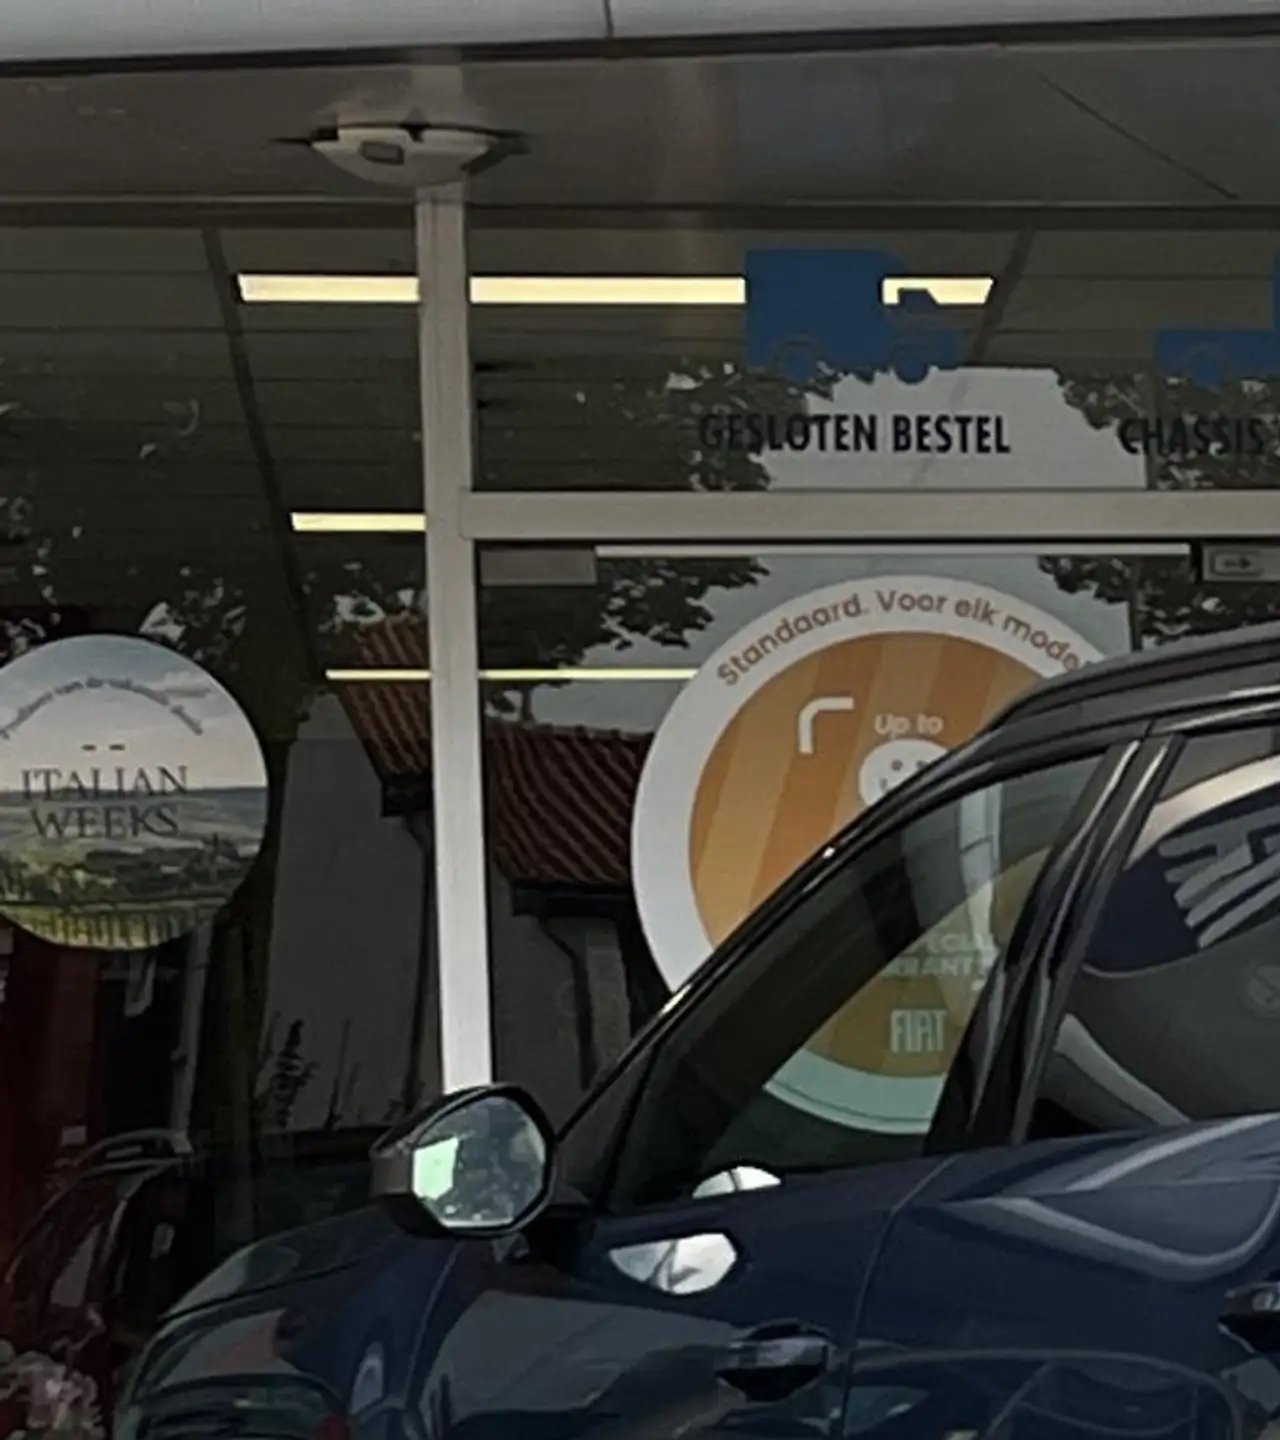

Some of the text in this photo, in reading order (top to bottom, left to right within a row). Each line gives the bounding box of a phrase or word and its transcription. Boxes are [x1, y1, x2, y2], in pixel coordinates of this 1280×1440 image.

[702, 413, 1012, 454] GESLOTEN BESTEL
[1116, 417, 1266, 455] CHASSIS
[875, 588, 947, 614] Voor
[953, 596, 999, 627] elk
[1002, 613, 1092, 674] mode
[874, 712, 945, 741] Up to
[21, 764, 189, 801] ITALIAN
[29, 804, 181, 841] WEEKS
[890, 1008, 947, 1054] FIAT
